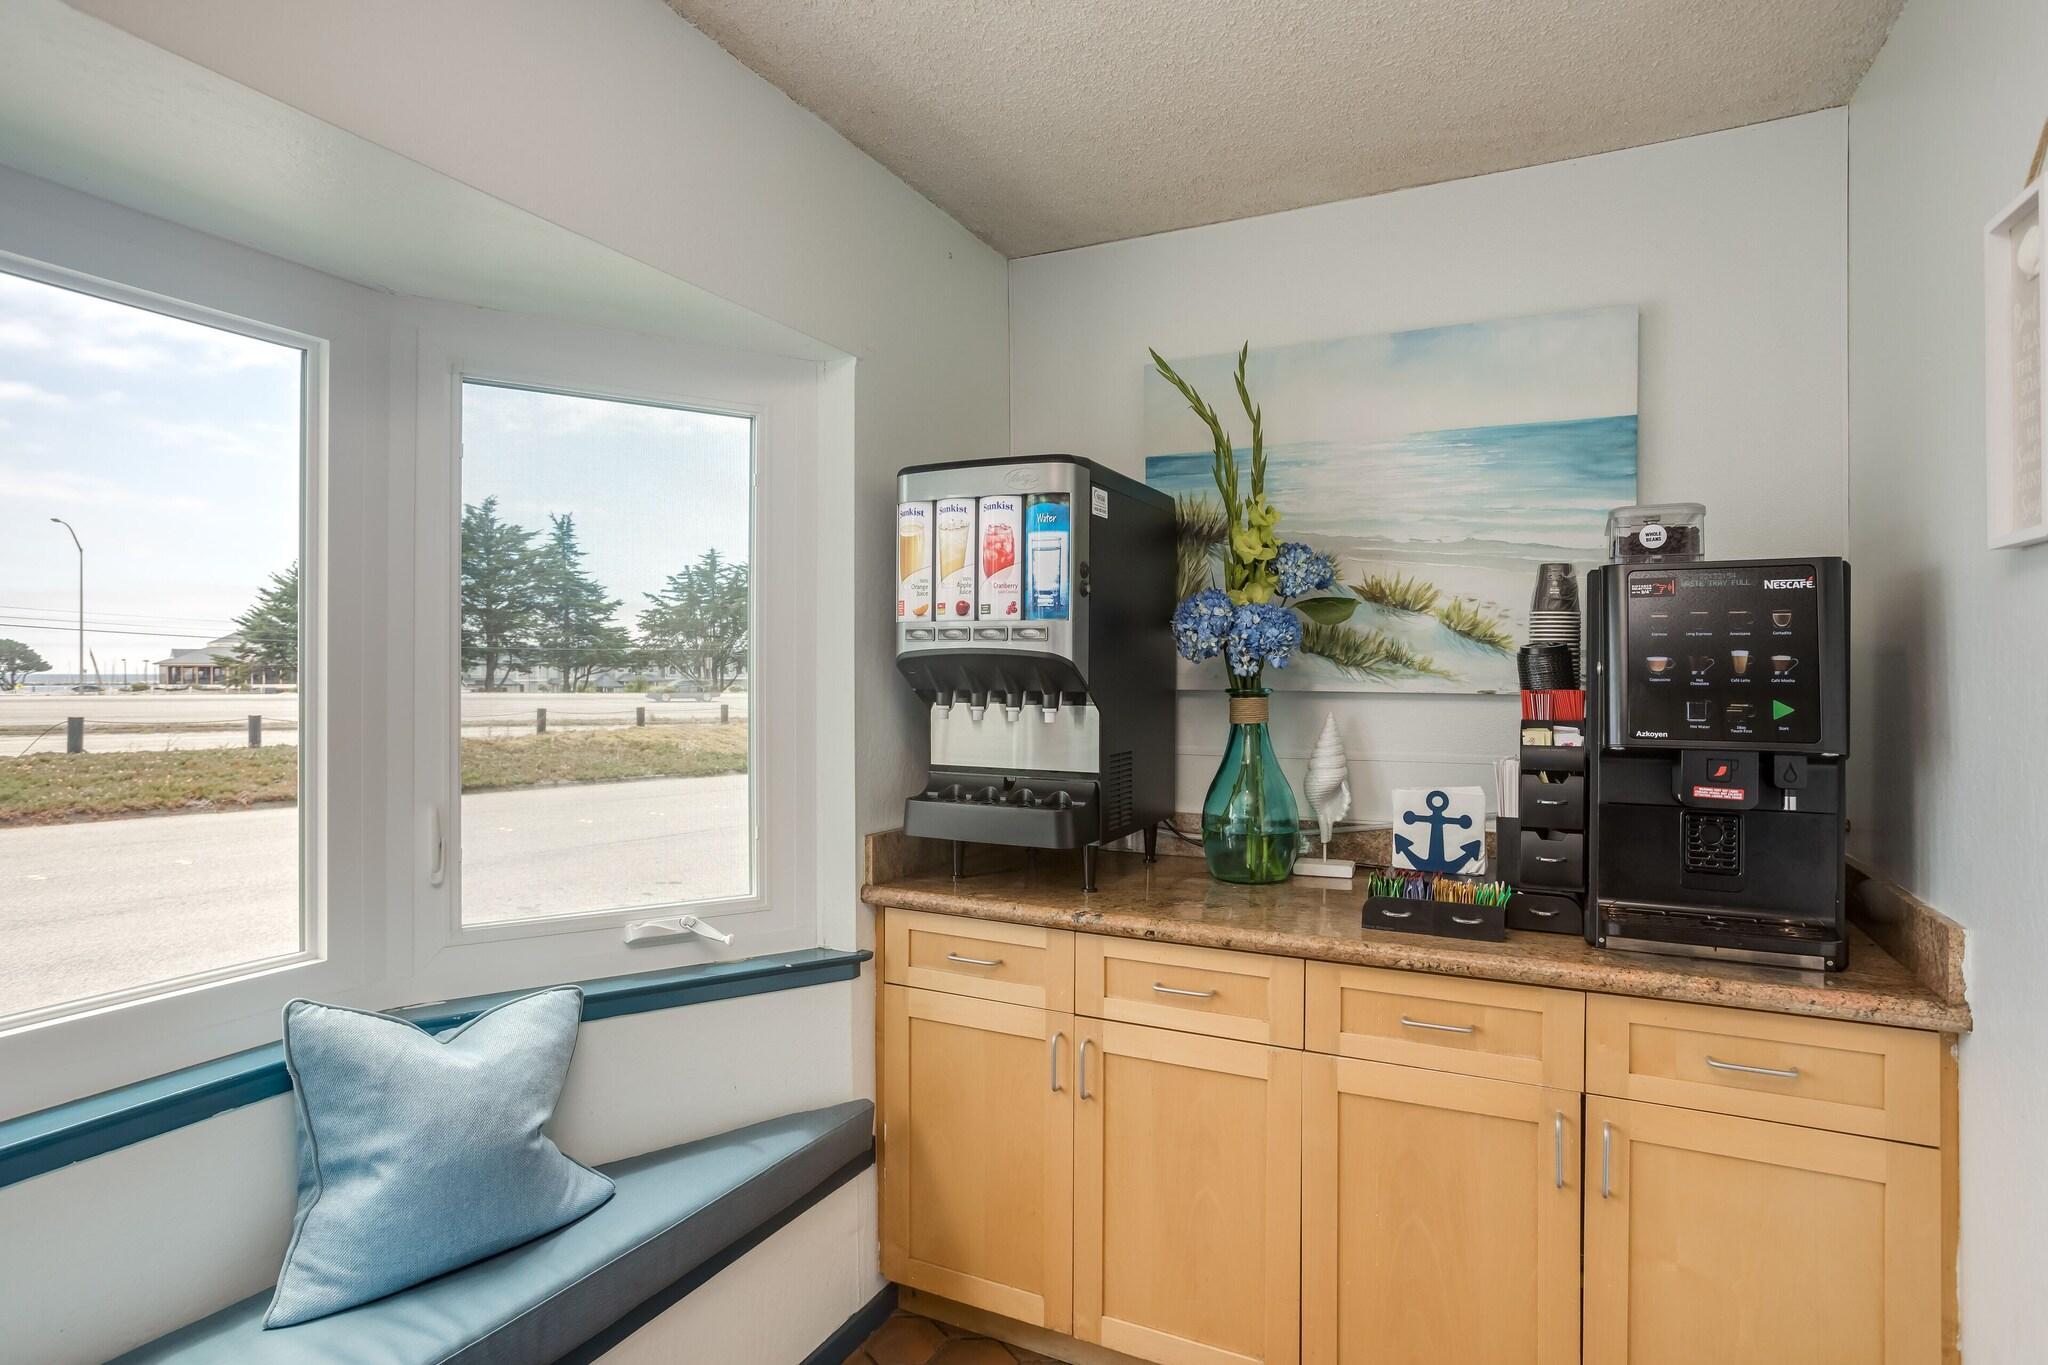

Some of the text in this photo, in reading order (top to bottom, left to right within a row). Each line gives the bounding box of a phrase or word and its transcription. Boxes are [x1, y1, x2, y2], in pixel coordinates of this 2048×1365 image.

[939, 503, 968, 515] Sunkist
[983, 501, 1014, 512] Sunkist
[1036, 513, 1057, 523] Water
[1636, 731, 1668, 739] Azkoyen
